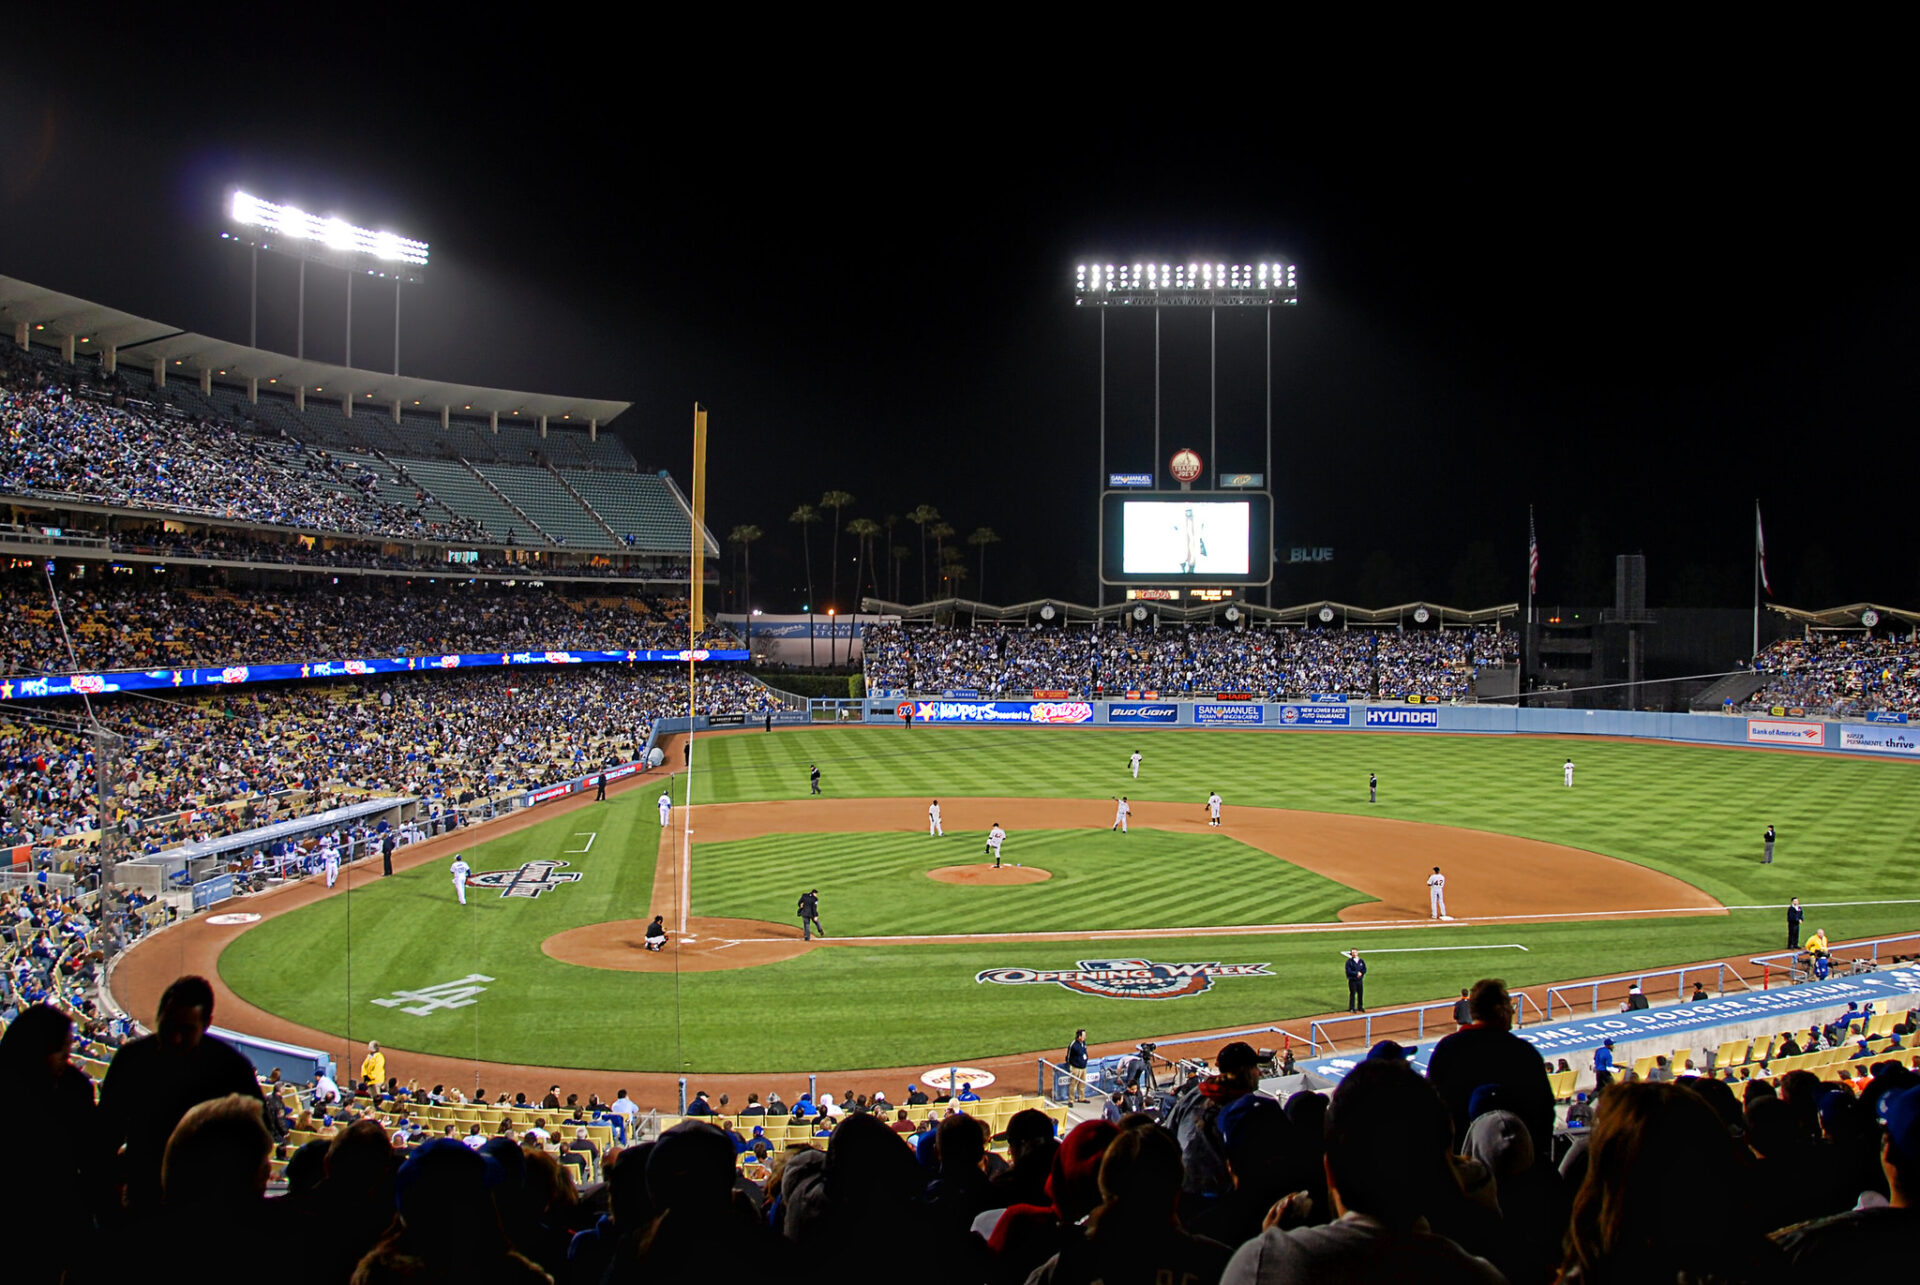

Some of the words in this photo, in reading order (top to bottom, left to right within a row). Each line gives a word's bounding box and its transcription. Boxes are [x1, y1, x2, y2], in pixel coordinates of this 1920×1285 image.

[1290, 548, 1334, 562] BLUE
[900, 705, 912, 715] 76
[1142, 708, 1175, 716] LIGHT
[1199, 706, 1216, 714] SAN
[1223, 706, 1259, 715] MANUEL
[1367, 711, 1436, 724] HYUNDAI
[1886, 738, 1915, 748] thrive
[991, 969, 1153, 983] OPENING
[1154, 963, 1269, 977] WEEK
[1109, 977, 1165, 985] 2009
[1584, 1020, 1627, 1031] TO
[1632, 1001, 1748, 1024] DODGER
[1747, 982, 1860, 1005] STADIUM
[1560, 1027, 1644, 1045] DEFENDING
[1645, 1015, 1718, 1030] NATIONAL
[1717, 1006, 1769, 1018] LEAGUE
[1769, 1001, 1803, 1010] WEST
[1805, 988, 1877, 1003] CHAMPIONS
